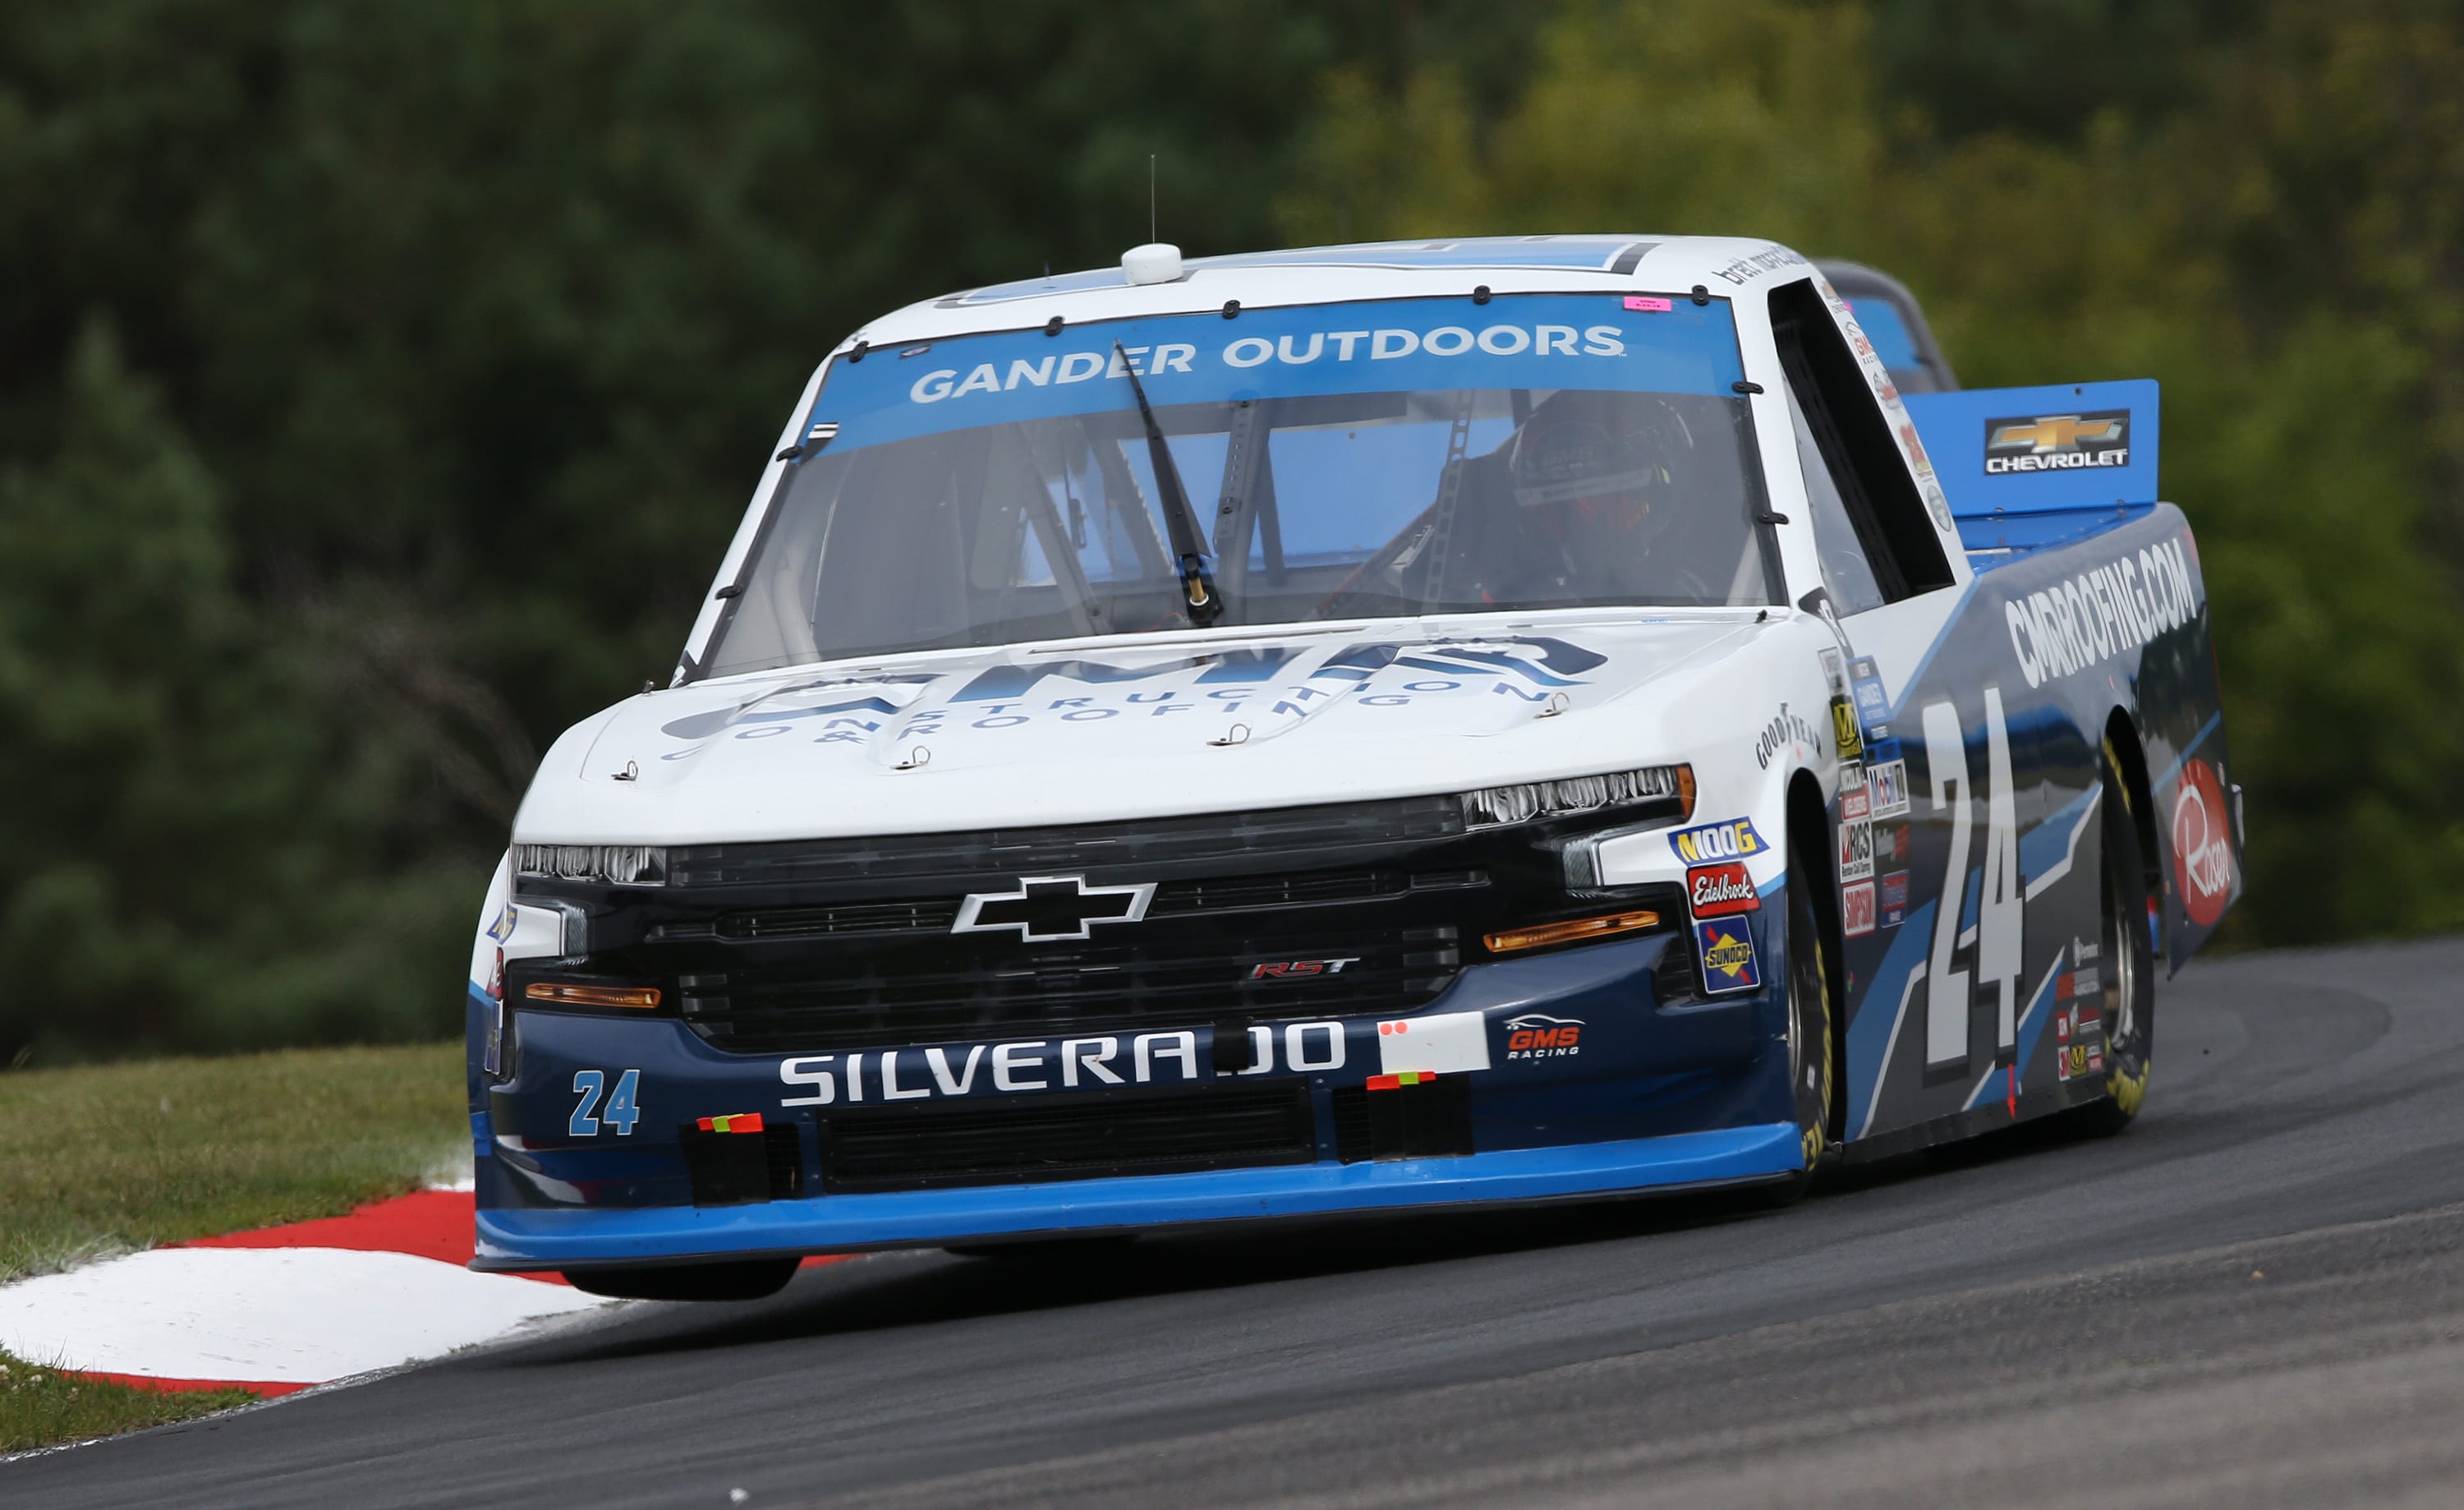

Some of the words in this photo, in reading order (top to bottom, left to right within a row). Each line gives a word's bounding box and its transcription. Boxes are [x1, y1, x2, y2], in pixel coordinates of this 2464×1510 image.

[910, 343, 1197, 404] GANDER
[1222, 324, 1625, 368] OUTDOORS
[1985, 448, 2129, 474] CHEVROLET
[2005, 538, 2197, 689] CMRROOFING.COM
[897, 694, 1411, 741] ROOFING
[1756, 702, 1823, 771] GOODYEAR
[1677, 821, 1758, 863] MOOG
[1693, 873, 1754, 907] Edelbrock
[1922, 687, 2024, 1065] 24
[1248, 956, 1361, 981] RST
[1708, 944, 1749, 967] SUNOCO
[1507, 1047, 1579, 1060] RACING
[1508, 1027, 1580, 1050] GMS
[568, 1069, 641, 1137] 24
